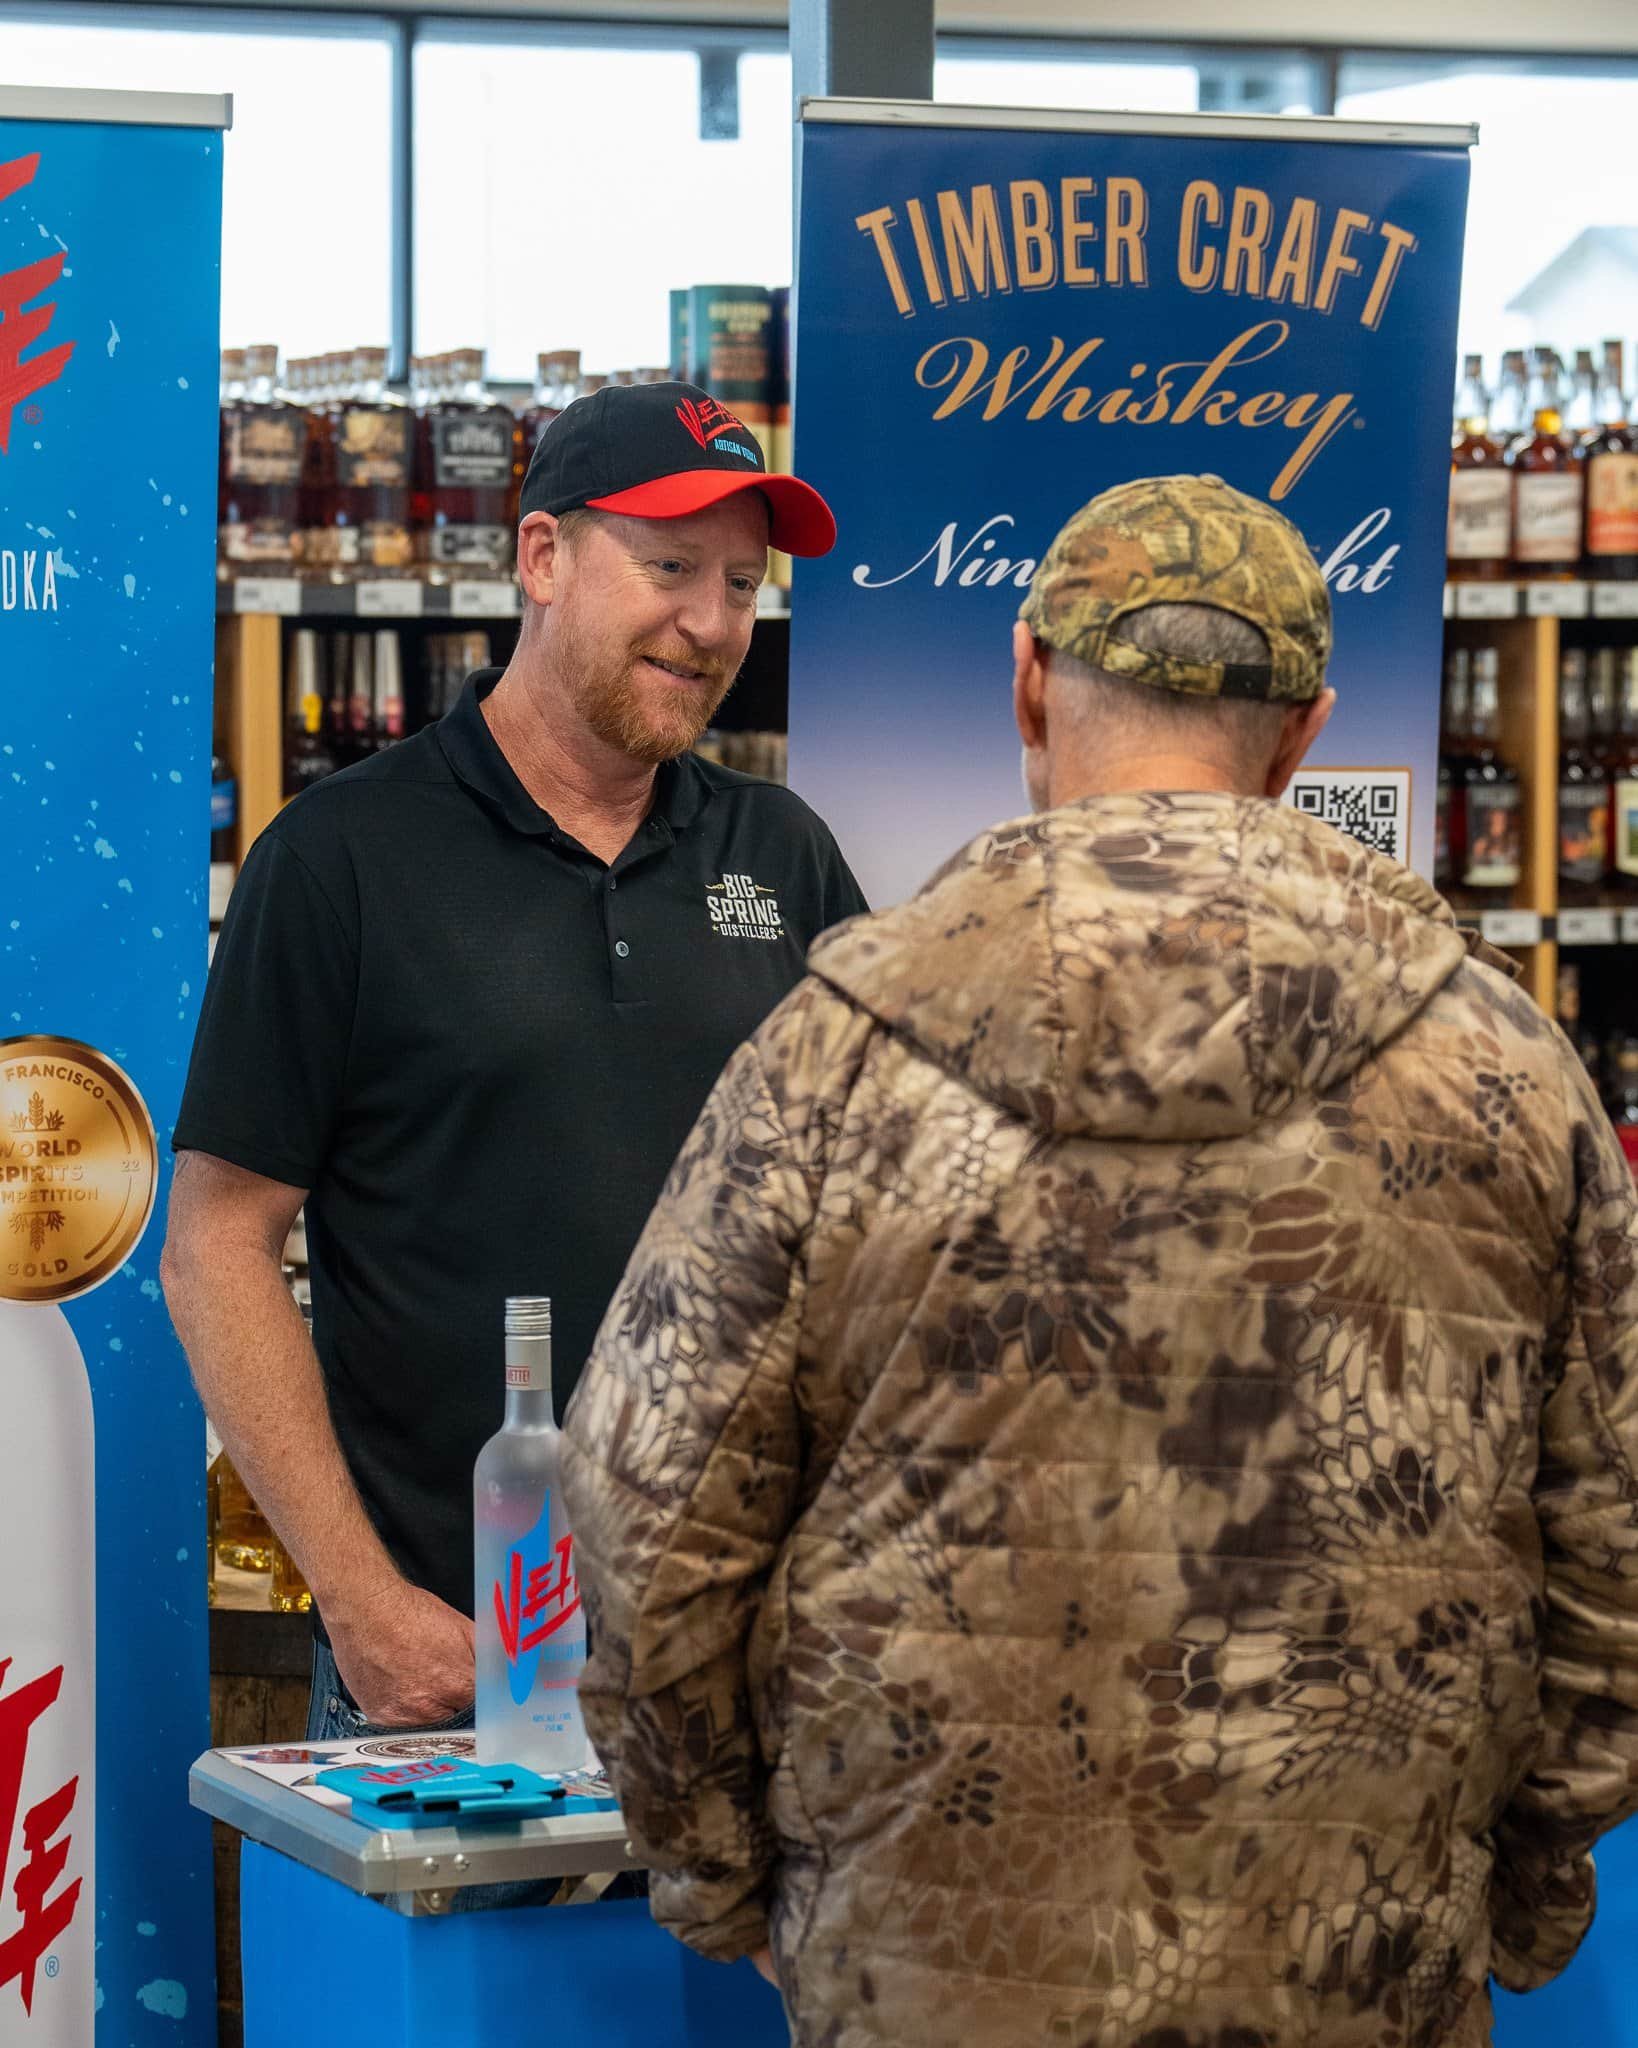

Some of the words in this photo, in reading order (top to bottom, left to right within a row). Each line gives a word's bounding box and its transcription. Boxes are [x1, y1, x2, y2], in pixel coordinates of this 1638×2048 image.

[855, 176, 1149, 320] TIMBER
[1178, 180, 1418, 331] CRAFT
[914, 319, 1357, 501] Whiskey
[852, 513, 1037, 588] Nin
[1320, 507, 1401, 593] ht
[1, 551, 59, 612] DKA
[722, 873, 757, 899] BIG
[706, 895, 782, 927] SPRING
[719, 923, 778, 940] DISTILLERS
[4, 1063, 105, 1099] FRANCISCO
[0, 1188, 98, 1203] MPETITION
[7, 1258, 69, 1278] GOLD
